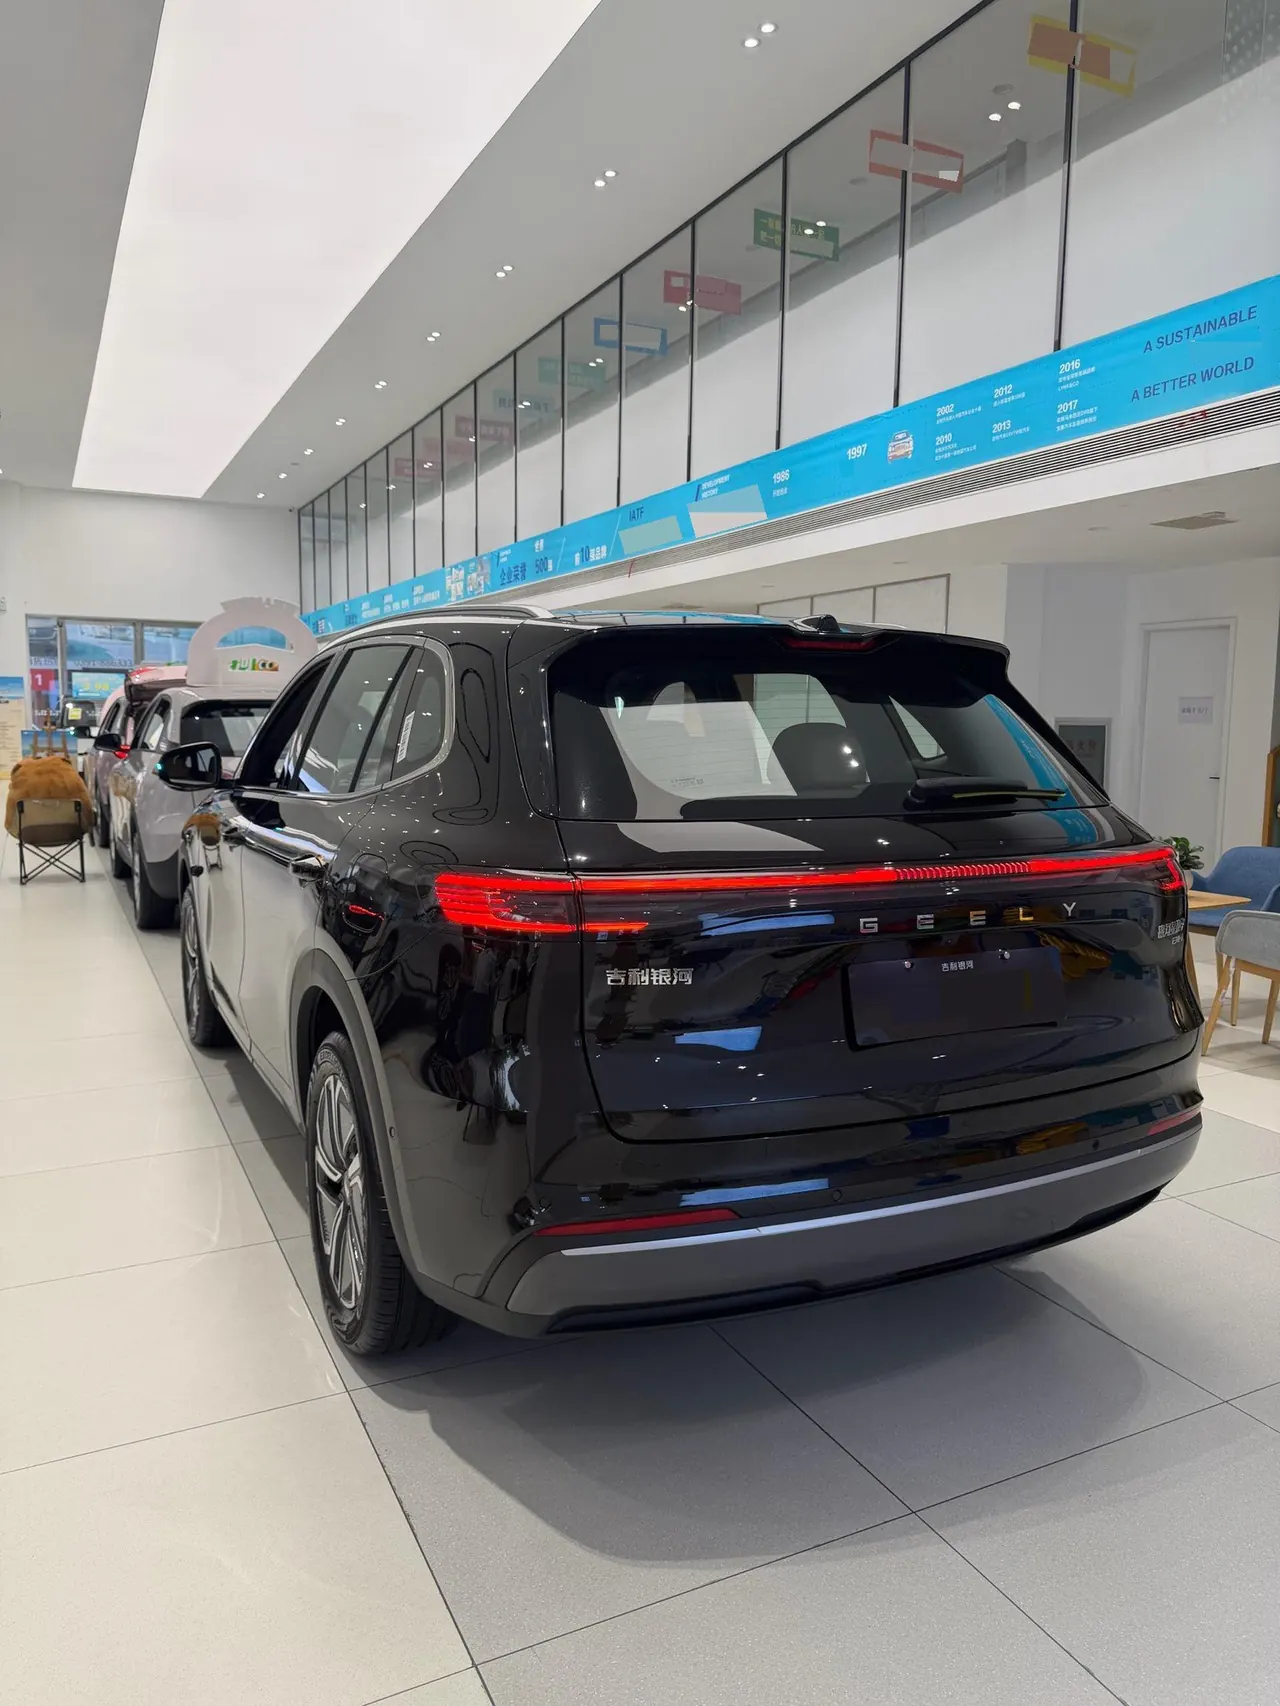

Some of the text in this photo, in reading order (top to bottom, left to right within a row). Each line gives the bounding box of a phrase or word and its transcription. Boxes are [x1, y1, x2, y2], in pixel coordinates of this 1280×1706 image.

[1143, 305, 1258, 353] A SUSTAINABLE
[1059, 359, 1081, 374] 2016
[1131, 356, 1255, 402] A BETTER WORLD
[993, 383, 1013, 399] 2012
[936, 403, 955, 418] 2002
[1057, 399, 1079, 414] 2017
[992, 419, 1012, 434] 2013
[935, 433, 953, 446] 2010
[847, 443, 868, 460] 1997
[772, 469, 790, 484] 1986
[628, 506, 644, 522] IATF
[859, 902, 1077, 934] GEELY
[605, 967, 695, 986] 吉利银河
